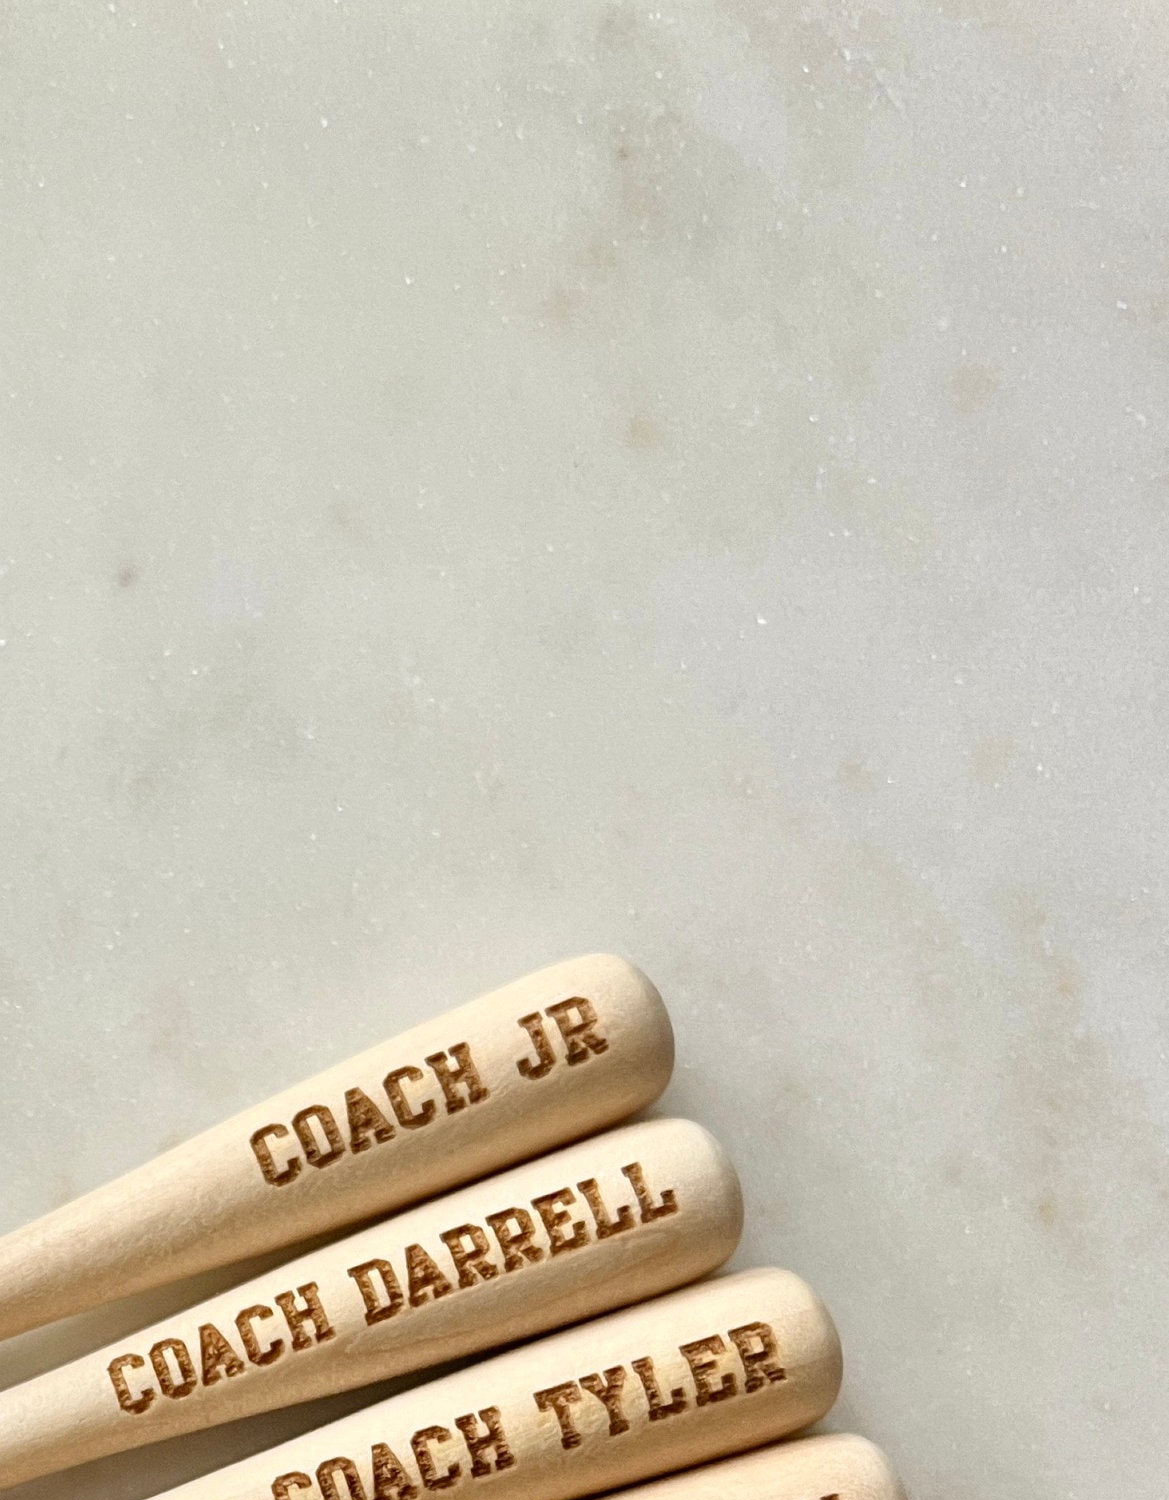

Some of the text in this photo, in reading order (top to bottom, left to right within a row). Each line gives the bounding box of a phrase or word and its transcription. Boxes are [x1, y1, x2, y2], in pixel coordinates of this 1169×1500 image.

[249, 996, 610, 1187] COACH JR
[107, 1163, 679, 1414] COACH DARRELL
[534, 1321, 786, 1449] TYLER
